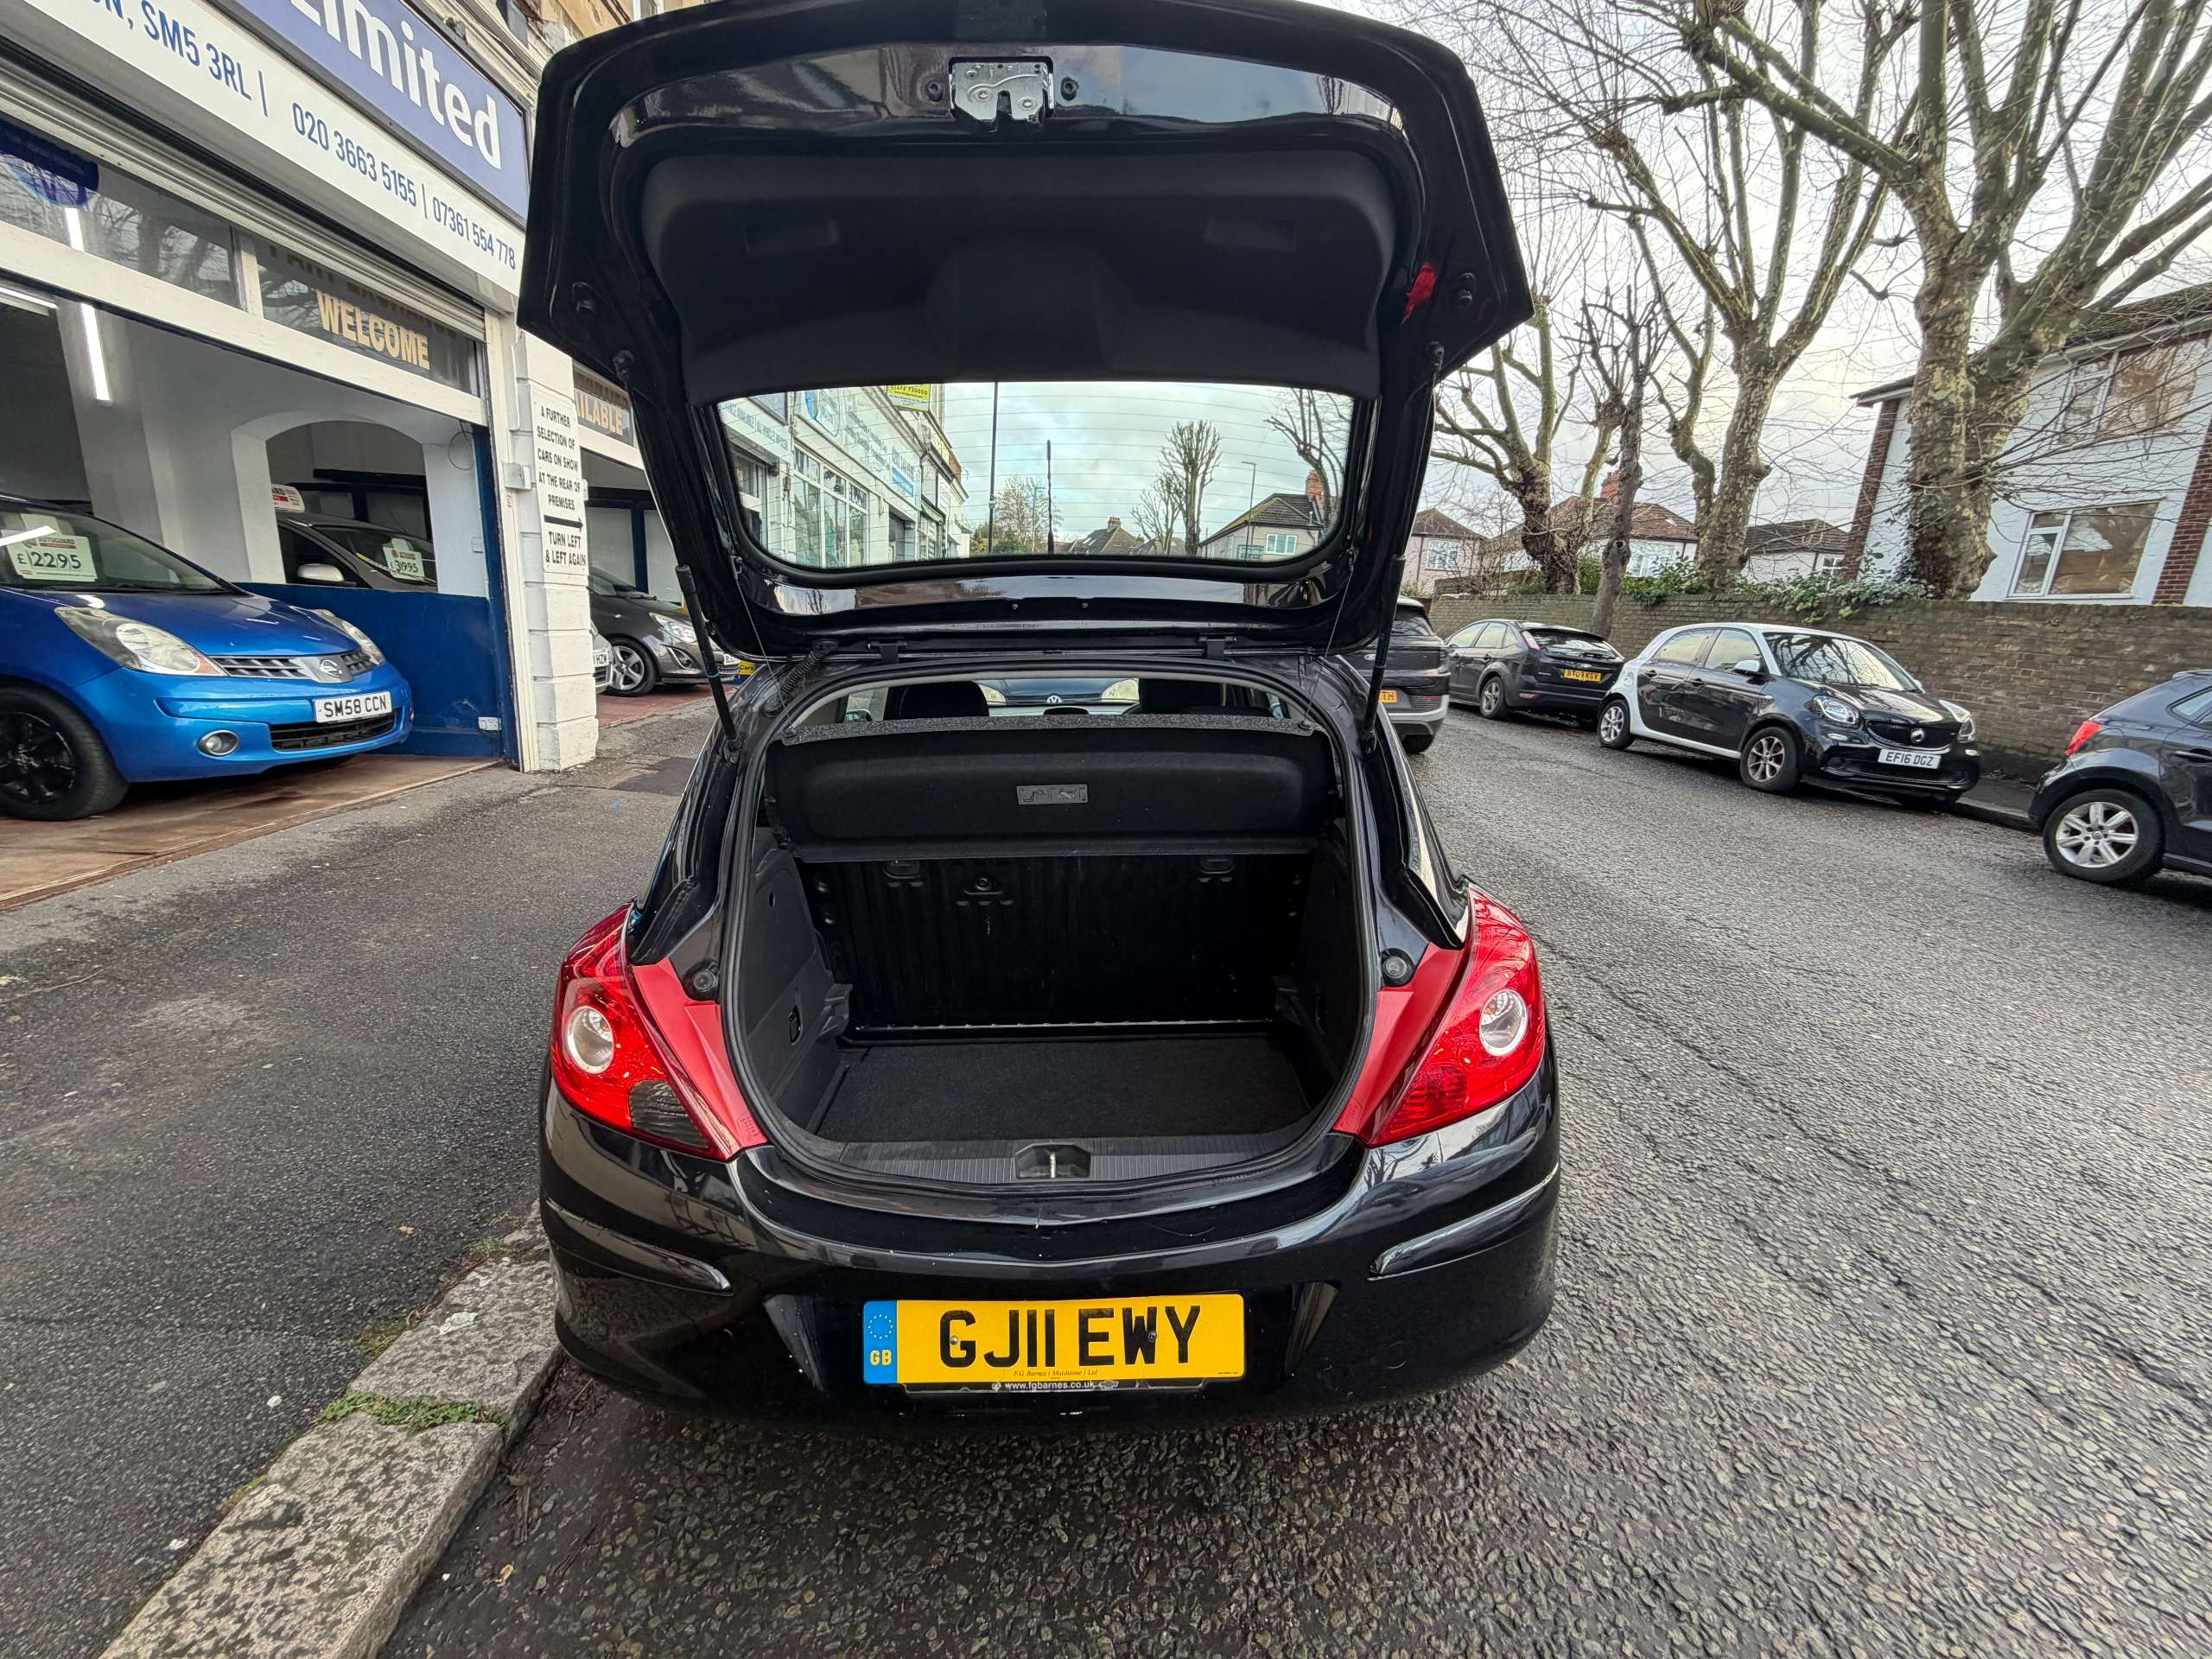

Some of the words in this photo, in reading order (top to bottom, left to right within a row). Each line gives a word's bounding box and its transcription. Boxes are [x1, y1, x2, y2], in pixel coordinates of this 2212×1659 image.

[142, 0, 200, 67] SM5
[206, 43, 252, 101] 3RL
[292, 103, 329, 151] 020
[334, 130, 378, 182] 3663
[381, 162, 417, 207] 5155
[432, 197, 469, 241] 07361
[472, 222, 494, 257] 554
[497, 238, 516, 270] 778
[316, 289, 430, 370] WELCOME
[541, 405, 545, 417] A
[545, 408, 570, 428] FURTHER
[537, 425, 568, 448] SELECTION
[568, 437, 575, 449] OF
[537, 448, 553, 464] CARS
[553, 454, 562, 467] ON
[563, 456, 579, 472] SHOW
[538, 471, 545, 484] AT
[546, 473, 558, 487] THE
[558, 476, 573, 490] REAR
[574, 480, 581, 493] OF
[548, 493, 575, 511] PREMISES
[548, 531, 566, 546] TURN
[567, 534, 582, 549] LEFT
[545, 549, 550, 563] &
[551, 550, 567, 565] LEFT
[569, 553, 587, 567] AGAIN
[323, 698, 362, 718] SM58
[365, 695, 387, 712] CCN
[1885, 751, 1912, 764] EF16
[1913, 755, 1935, 766] DGZ
[939, 1308, 1055, 1369] GJ11
[1078, 1306, 1201, 1367] EWY
[870, 1350, 893, 1366] GB
[1005, 1380, 1094, 1391] www.fgbarnes.co.uk
